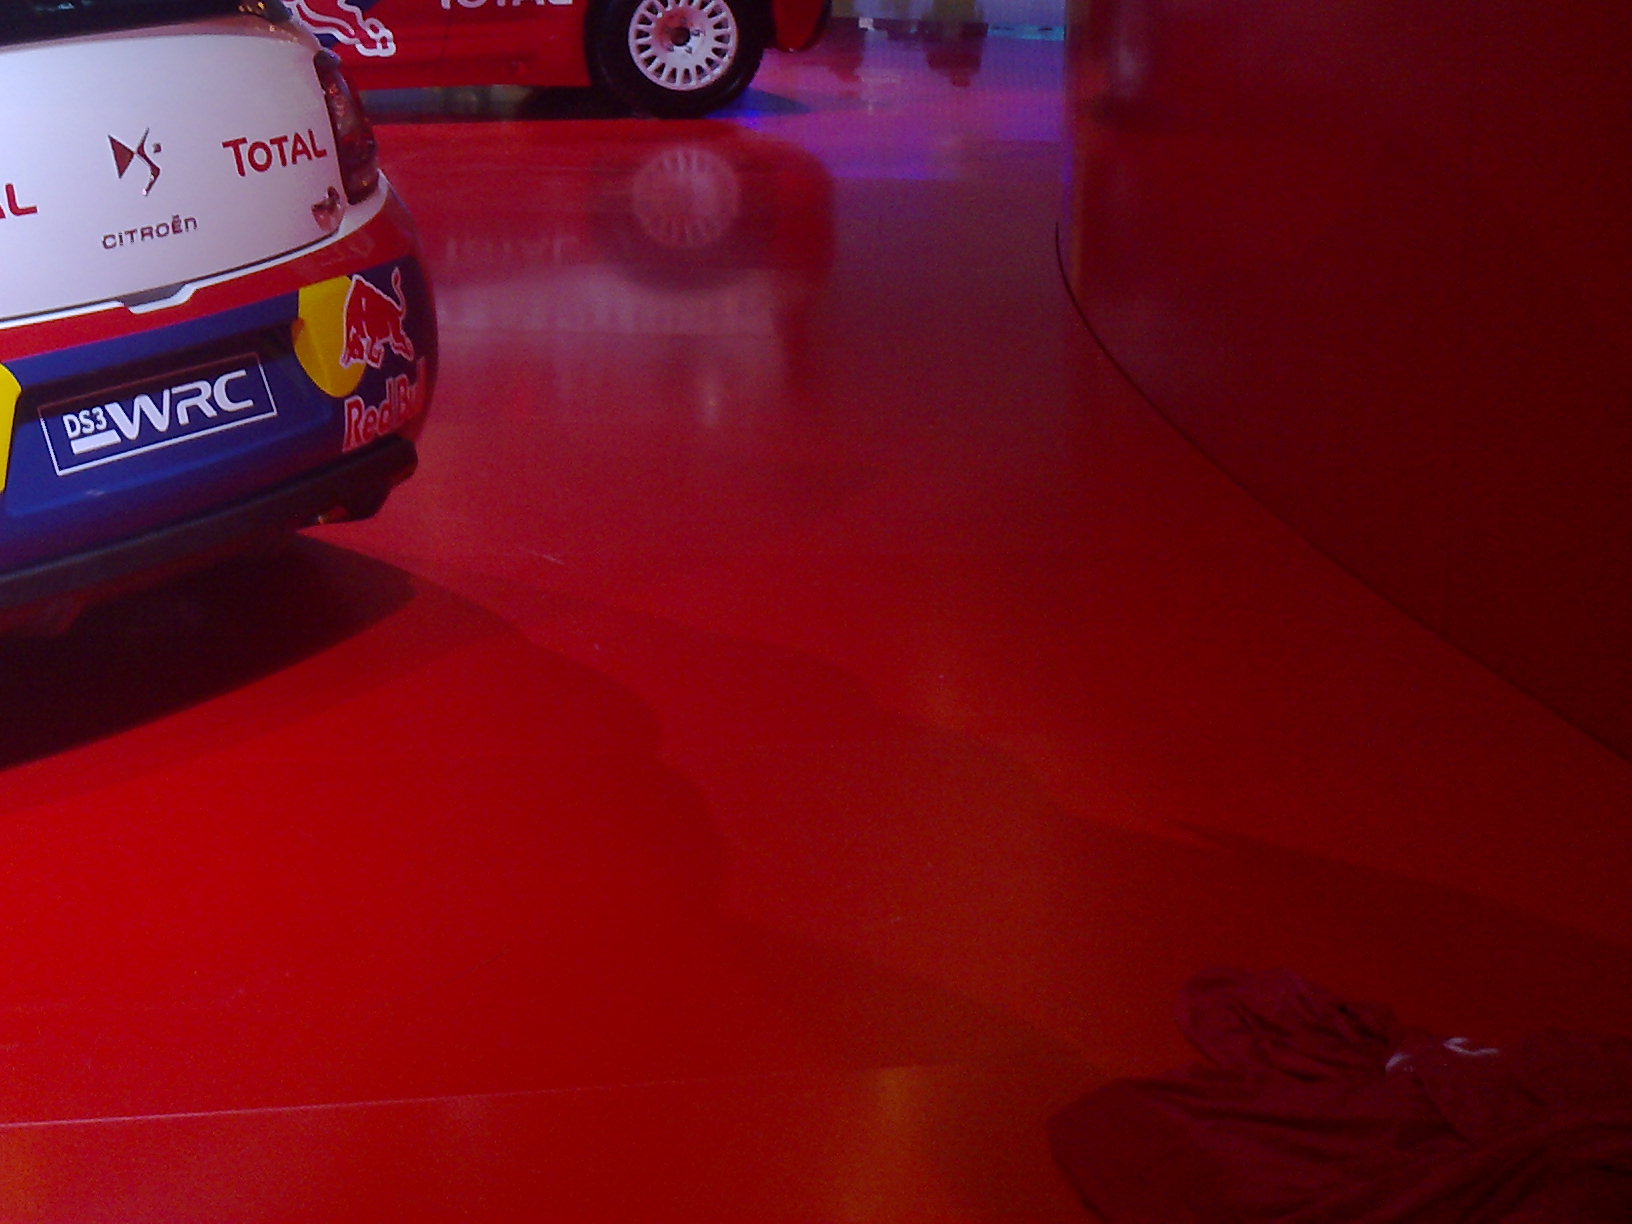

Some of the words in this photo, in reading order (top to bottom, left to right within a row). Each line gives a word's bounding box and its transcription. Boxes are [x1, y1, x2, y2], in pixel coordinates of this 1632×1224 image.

[222, 128, 328, 177] TOTAL
[62, 406, 108, 440] DS3
[104, 369, 255, 441] WRC
